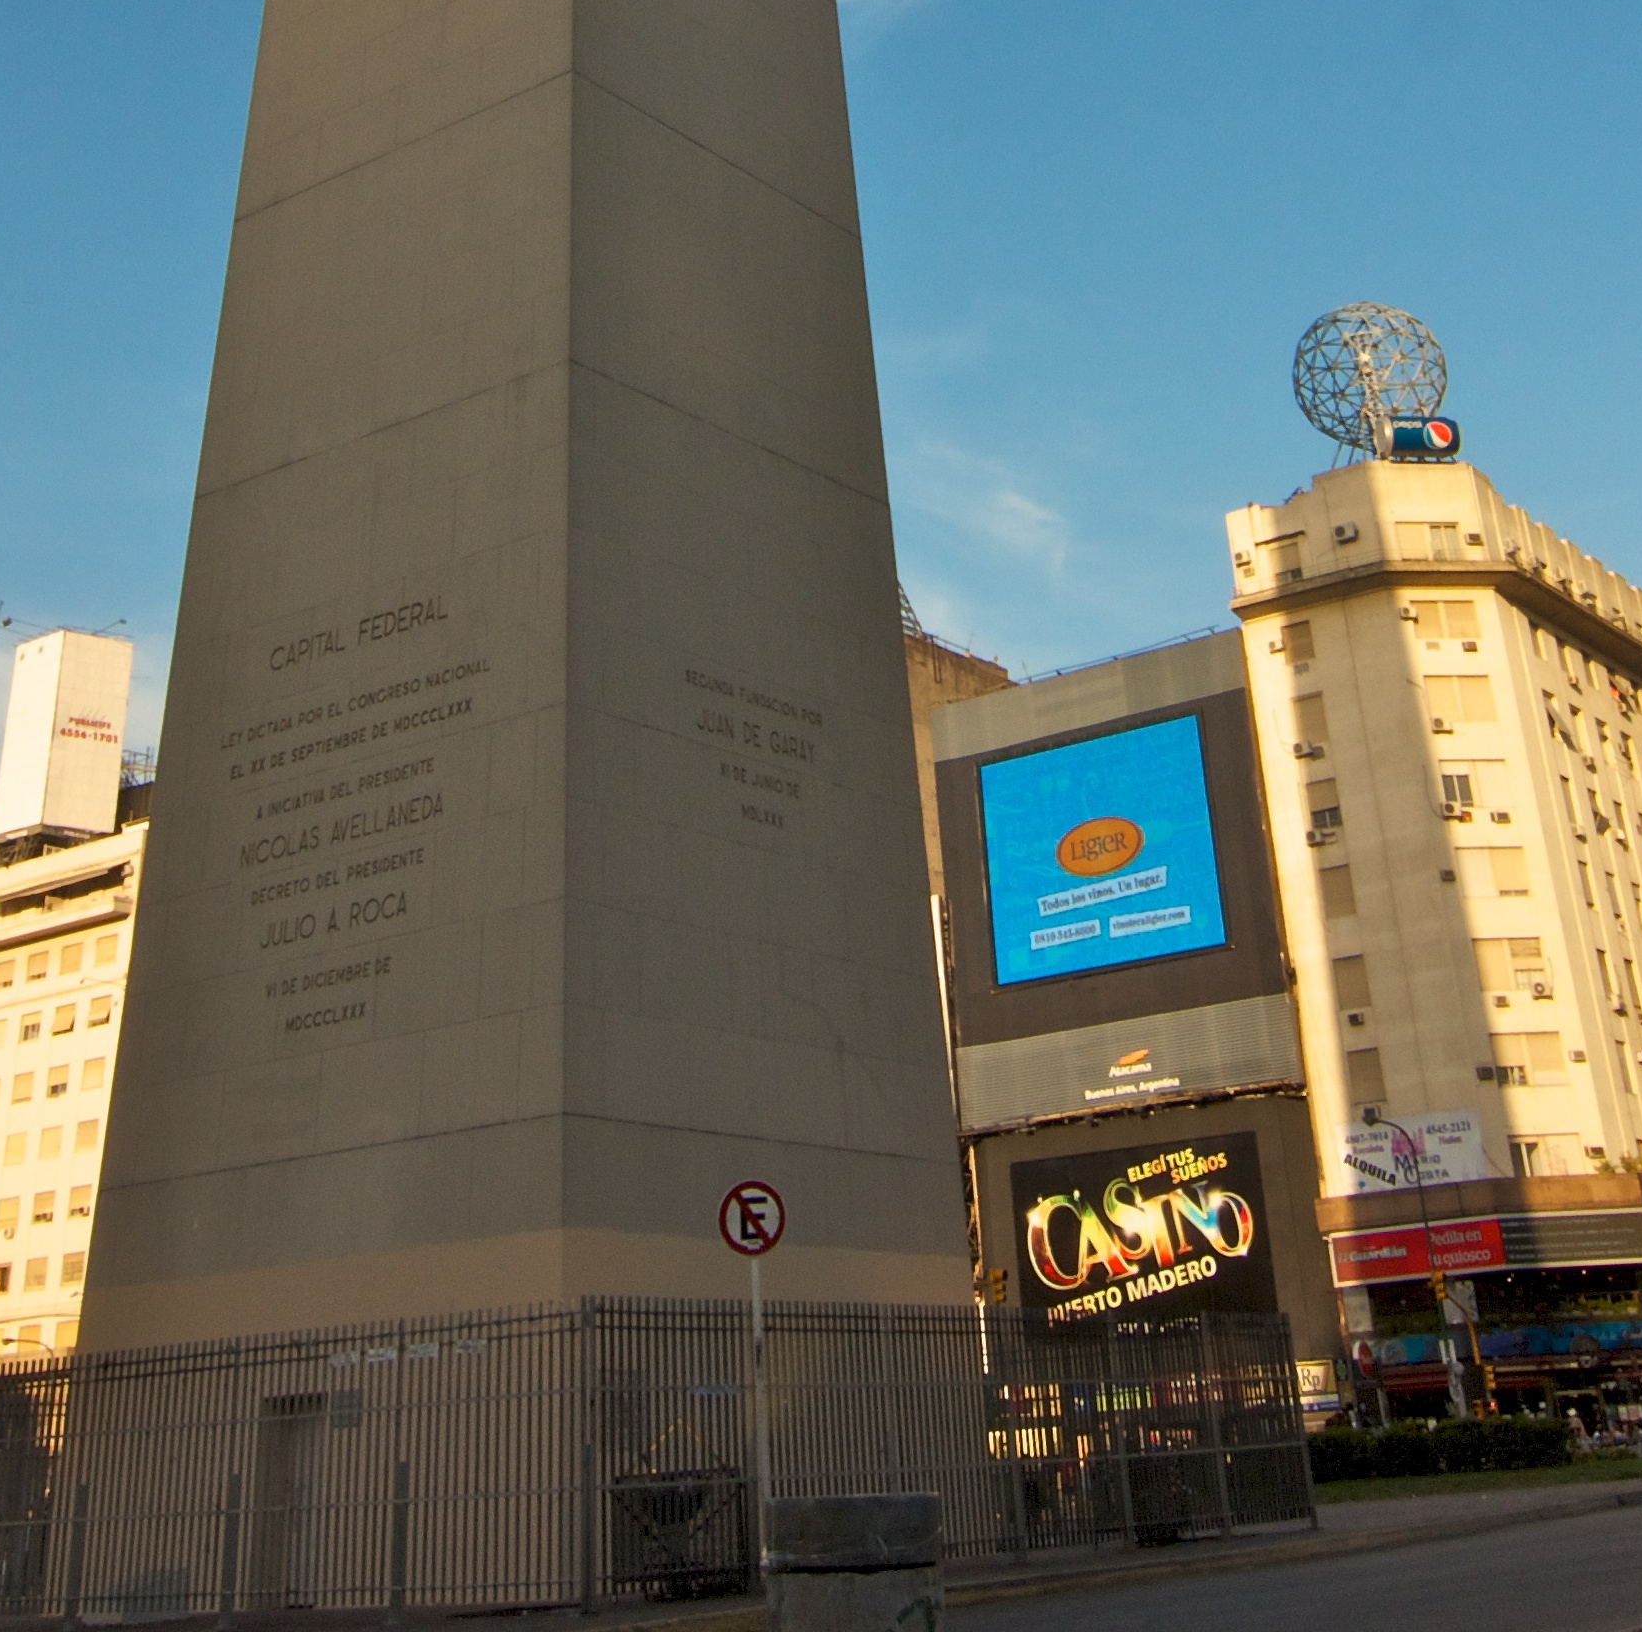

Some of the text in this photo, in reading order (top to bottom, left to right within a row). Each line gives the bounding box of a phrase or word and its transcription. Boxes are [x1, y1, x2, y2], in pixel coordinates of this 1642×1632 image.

[270, 595, 449, 671] CAPITAL FEDERAL
[220, 658, 491, 749] LEY DICTADA POR EL CONGRESO NACIONAL
[230, 765, 245, 780] EL
[270, 751, 286, 769] DE
[291, 727, 367, 763] SEPTIEMBRE
[371, 721, 388, 740] DE
[392, 698, 473, 733] MDCCCLXXX
[696, 708, 814, 765] JUAN DE GARAY
[267, 789, 325, 816] INICIATIVA
[330, 782, 353, 800] DEL
[358, 757, 435, 794] PRESIDENTE
[240, 792, 443, 869] NICOLAS AVELLANEDA
[251, 847, 425, 906] DECRETO DEL PRESIDENTE
[1042, 872, 1164, 912] Todos los vinos. Un lugar.
[260, 914, 316, 949] JULIO
[348, 892, 407, 928] ROCA
[281, 977, 298, 997] DE
[301, 960, 371, 992] DICIEMBRE
[374, 956, 392, 976] DE
[284, 1001, 367, 1033] MDCCCLXXX
[1084, 1089, 1114, 1100] Buenos
[1139, 1077, 1180, 1092] Argentina
[1109, 1062, 1152, 1078] Atacama
[1166, 1148, 1194, 1167] TUS
[1171, 1152, 1228, 1184] SUEÑOS
[1344, 1153, 1396, 1186] ALQUILA
[740, 1196, 768, 1240] E
[1027, 1178, 1254, 1290] CASINO
[1465, 1230, 1482, 1242] en
[1125, 1255, 1217, 1302] MADERO
[1443, 1248, 1491, 1268] quiosco
[1301, 1367, 1321, 1391] Rp
